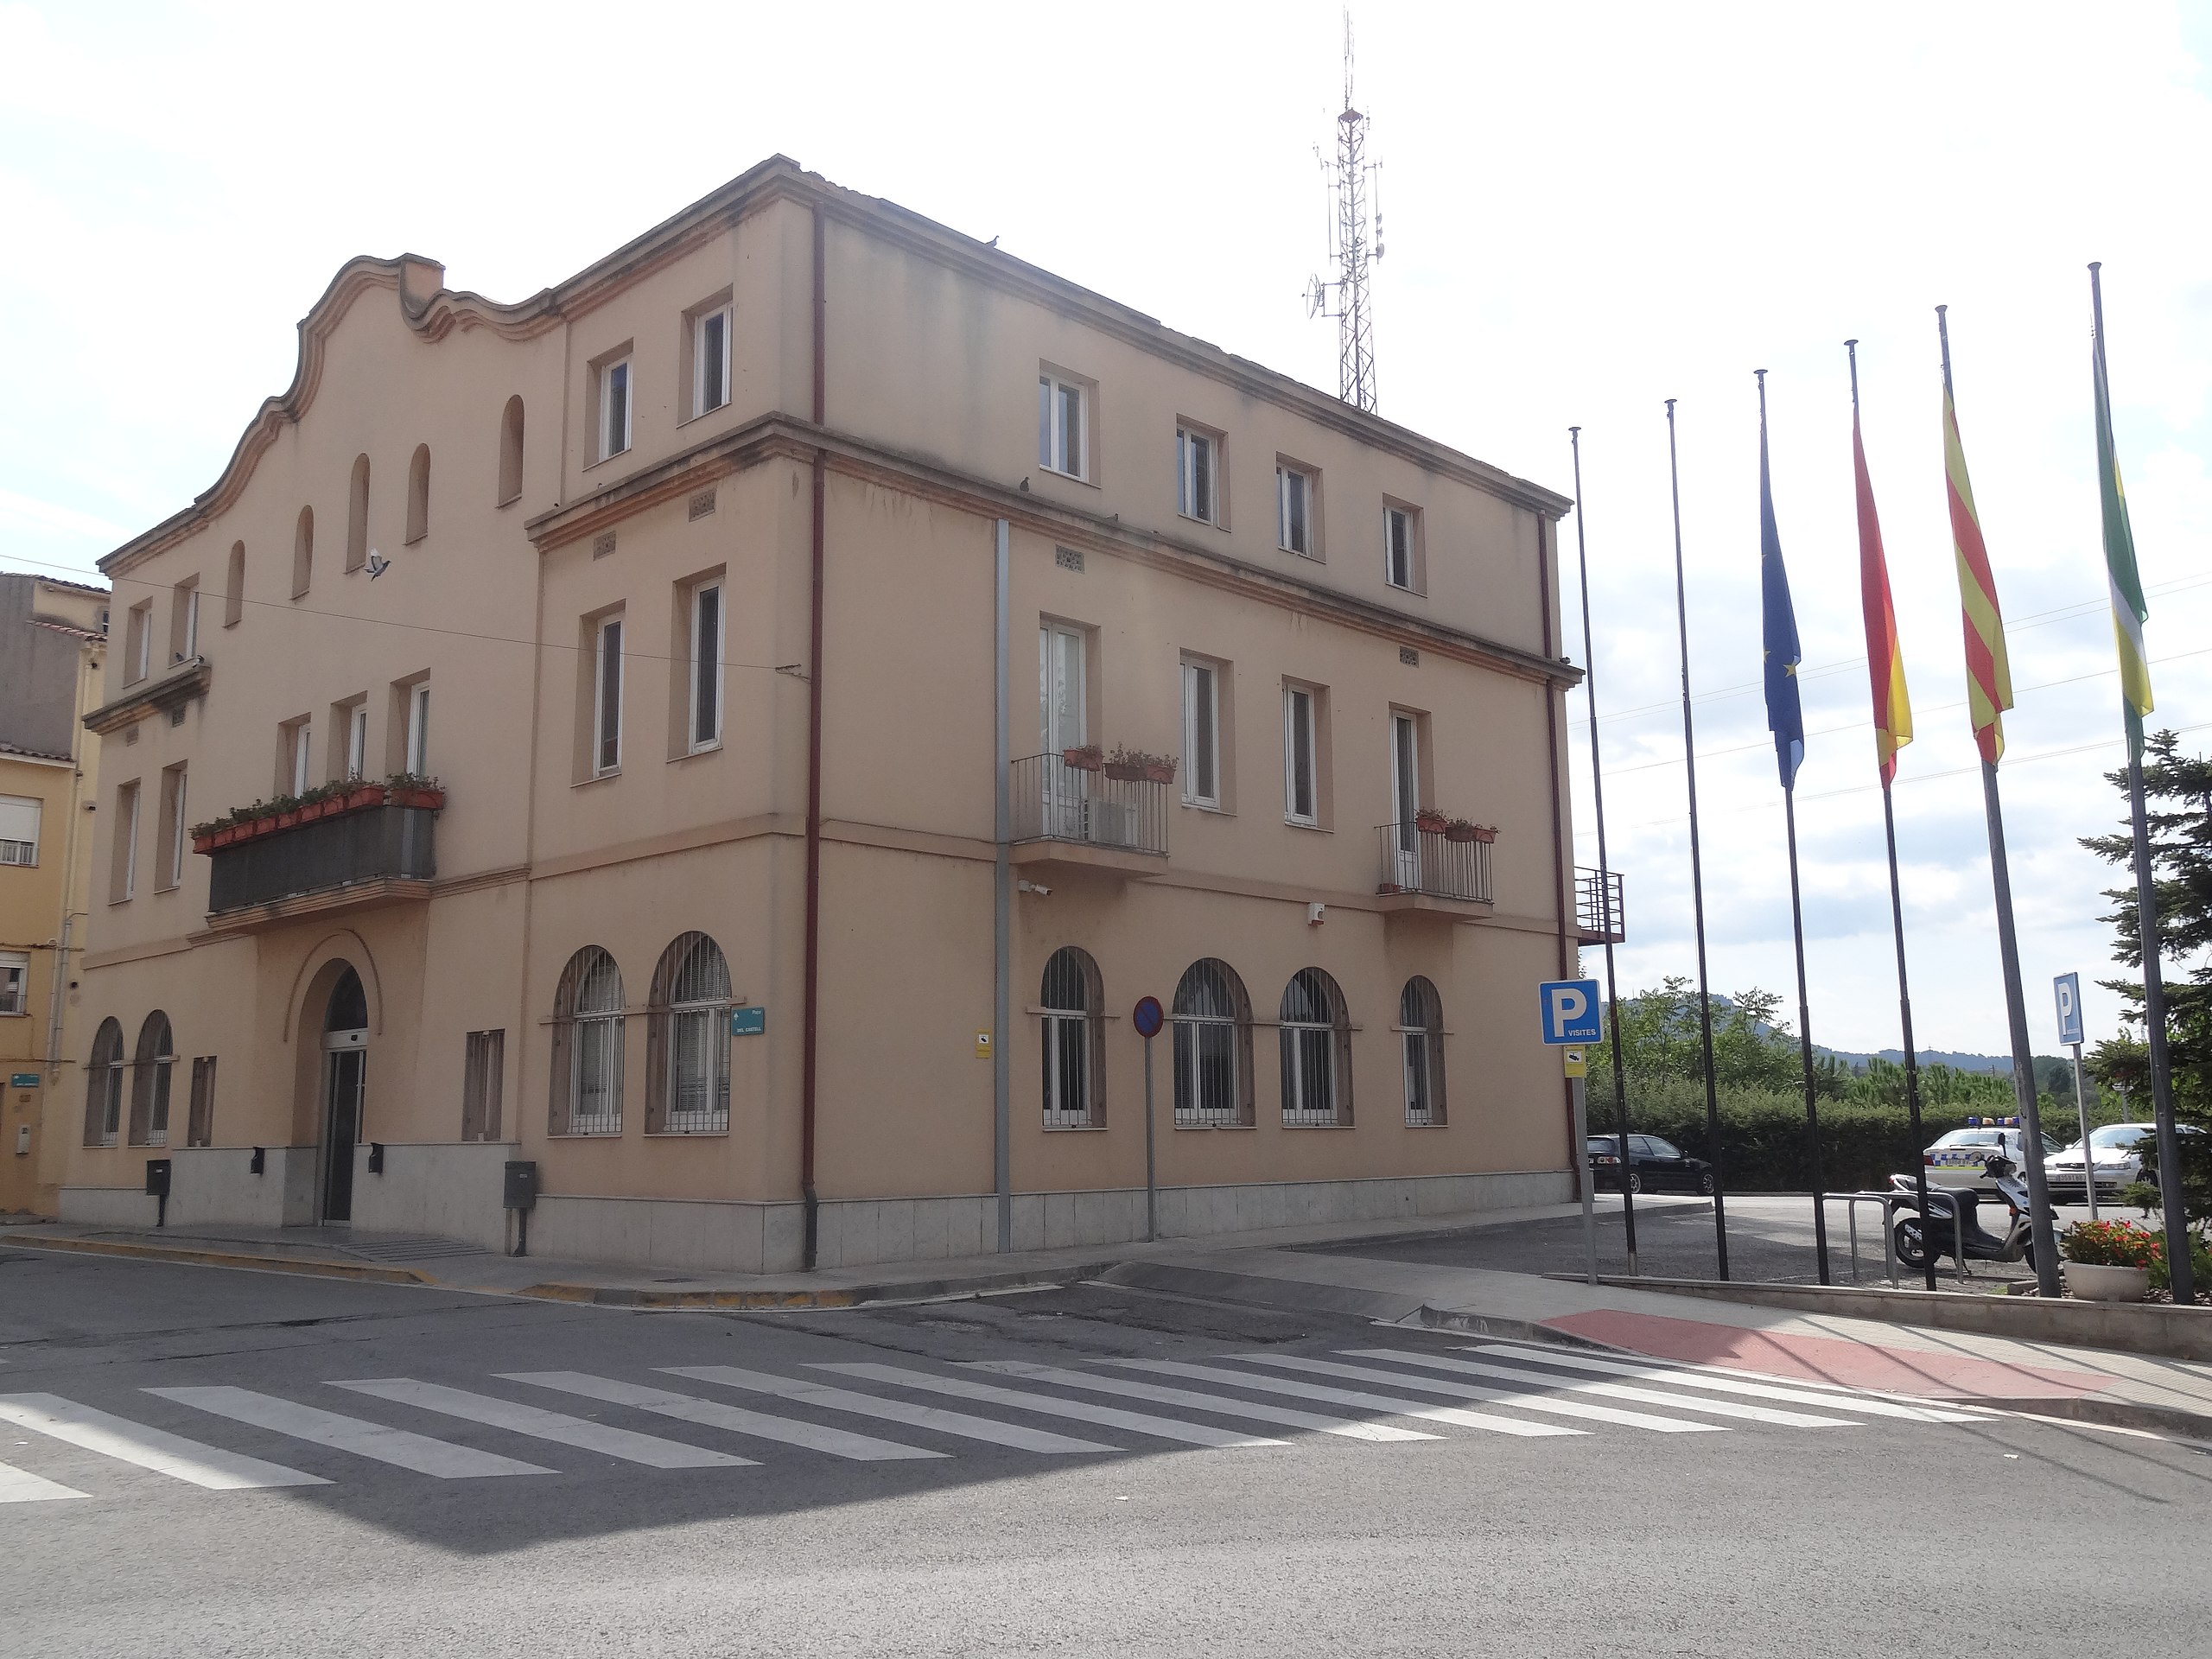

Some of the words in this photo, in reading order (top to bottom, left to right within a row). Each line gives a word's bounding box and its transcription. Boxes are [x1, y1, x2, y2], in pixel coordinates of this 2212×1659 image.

[1551, 988, 1587, 1037] P
[1567, 1028, 1597, 1037] VISITES
[2058, 982, 2072, 1035] P
